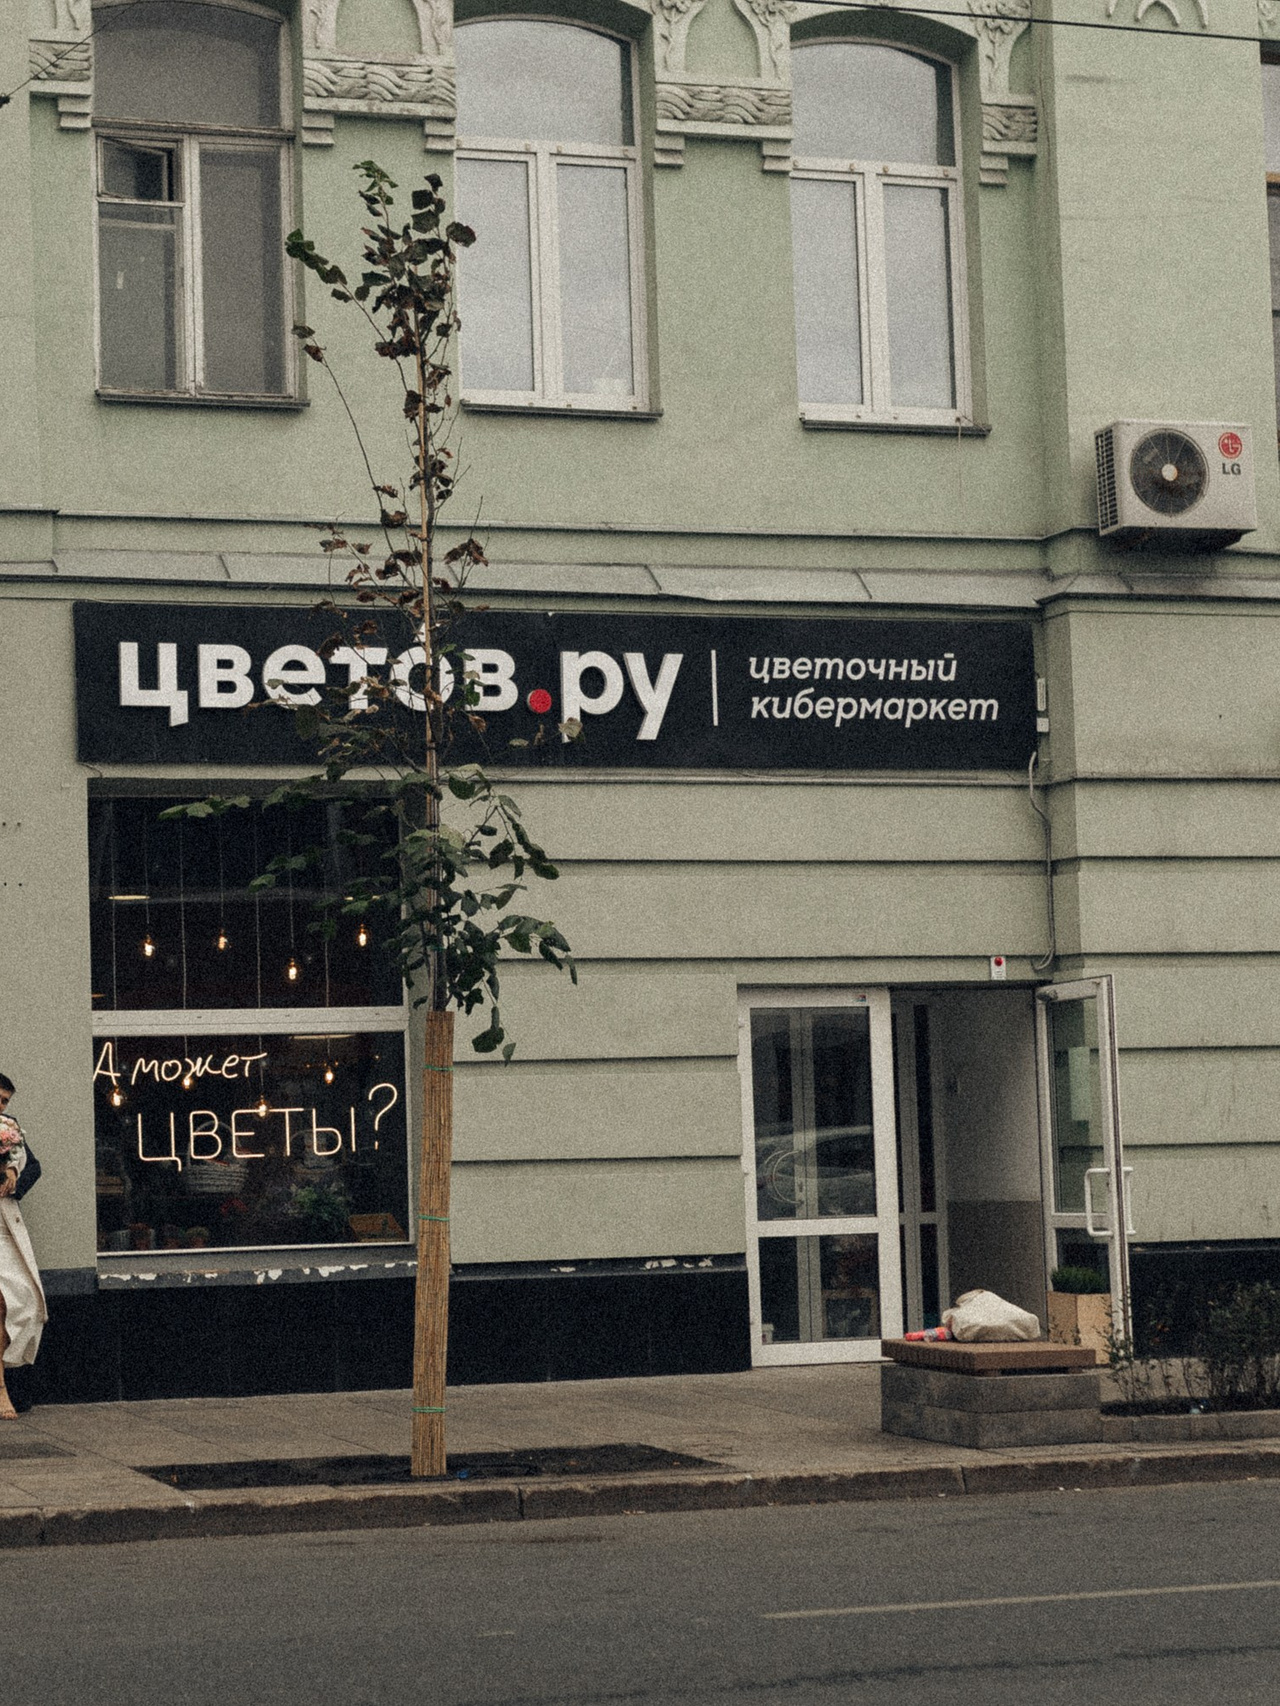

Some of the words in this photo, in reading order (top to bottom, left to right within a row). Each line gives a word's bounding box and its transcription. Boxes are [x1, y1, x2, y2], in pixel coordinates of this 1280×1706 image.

[1222, 462, 1241, 476] LG
[749, 653, 957, 683] цветочный
[751, 687, 999, 728] кибермаркет
[93, 1041, 120, 1085] А
[131, 1052, 268, 1085] может
[137, 1083, 398, 1172] ЦВЕТЫ?
